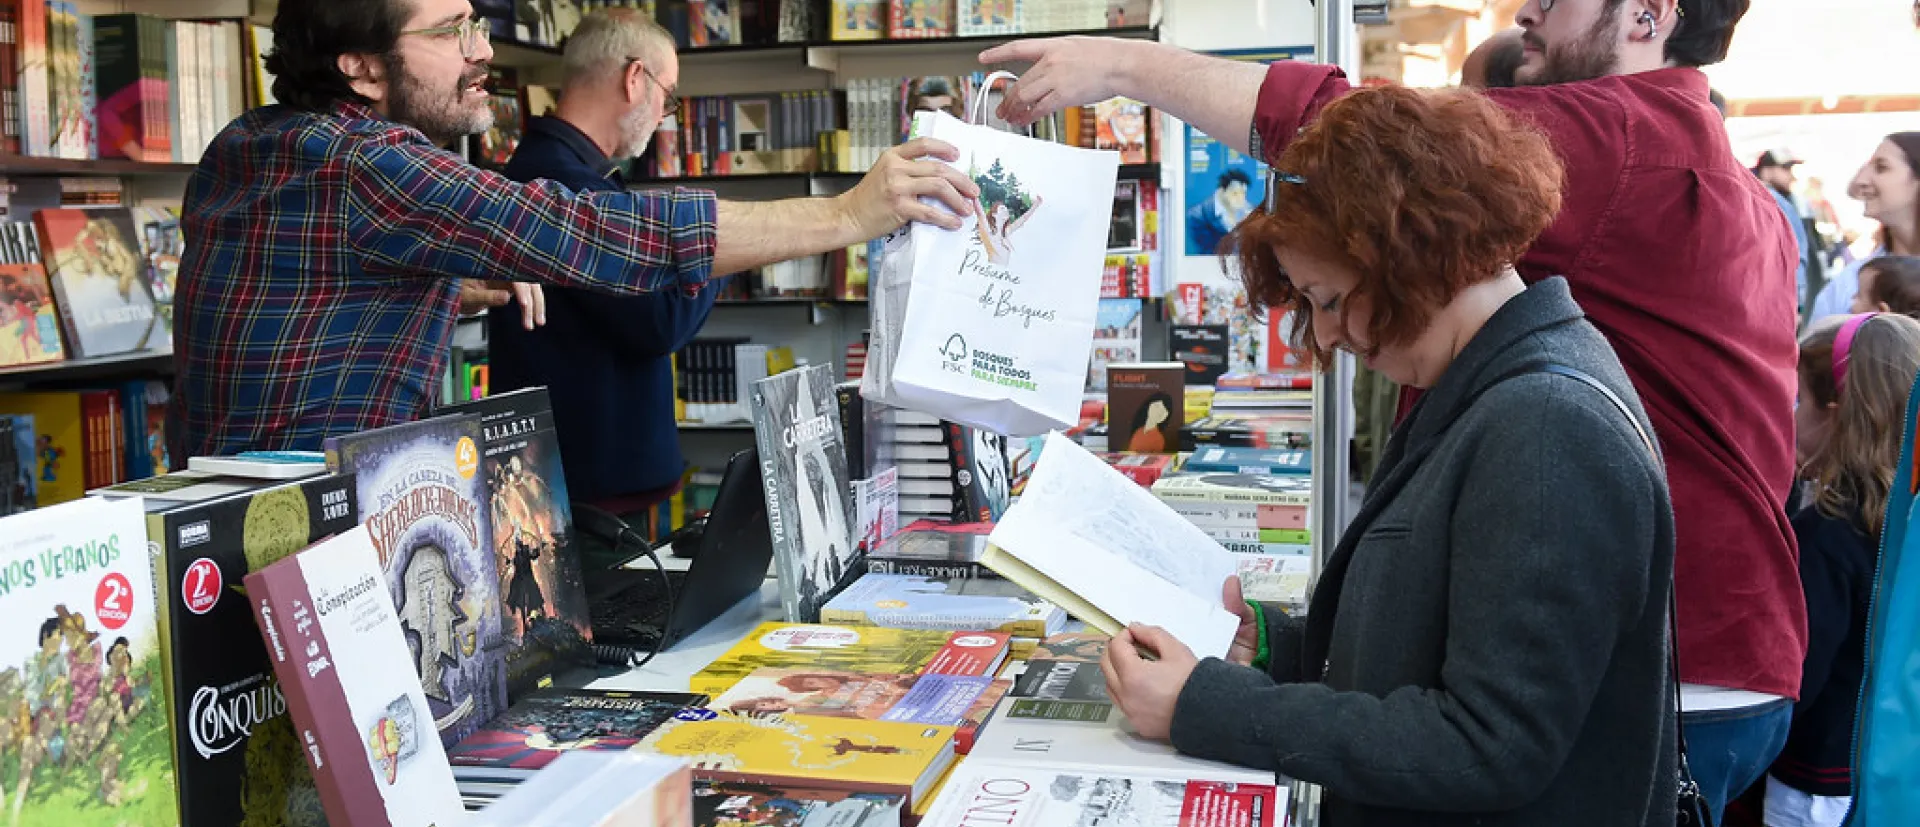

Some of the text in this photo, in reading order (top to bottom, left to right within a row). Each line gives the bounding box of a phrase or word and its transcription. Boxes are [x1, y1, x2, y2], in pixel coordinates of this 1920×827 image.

[958, 248, 1020, 285] Presume
[978, 283, 1057, 329] de Bosques
[942, 360, 965, 374] FSC
[972, 349, 1014, 367] BOSQUES
[972, 358, 1031, 380] PARA TODOS
[971, 367, 1038, 392] PARA SIEMPRE
[783, 413, 834, 448] CARRETERA
[408, 468, 445, 487] CABEZA
[763, 460, 774, 476] LA
[766, 477, 785, 544] CARRETERA
[39, 533, 121, 579] VERANOS
[103, 577, 129, 609] 2ª
[316, 574, 378, 617] Conspiración
[958, 778, 1031, 827] INO
